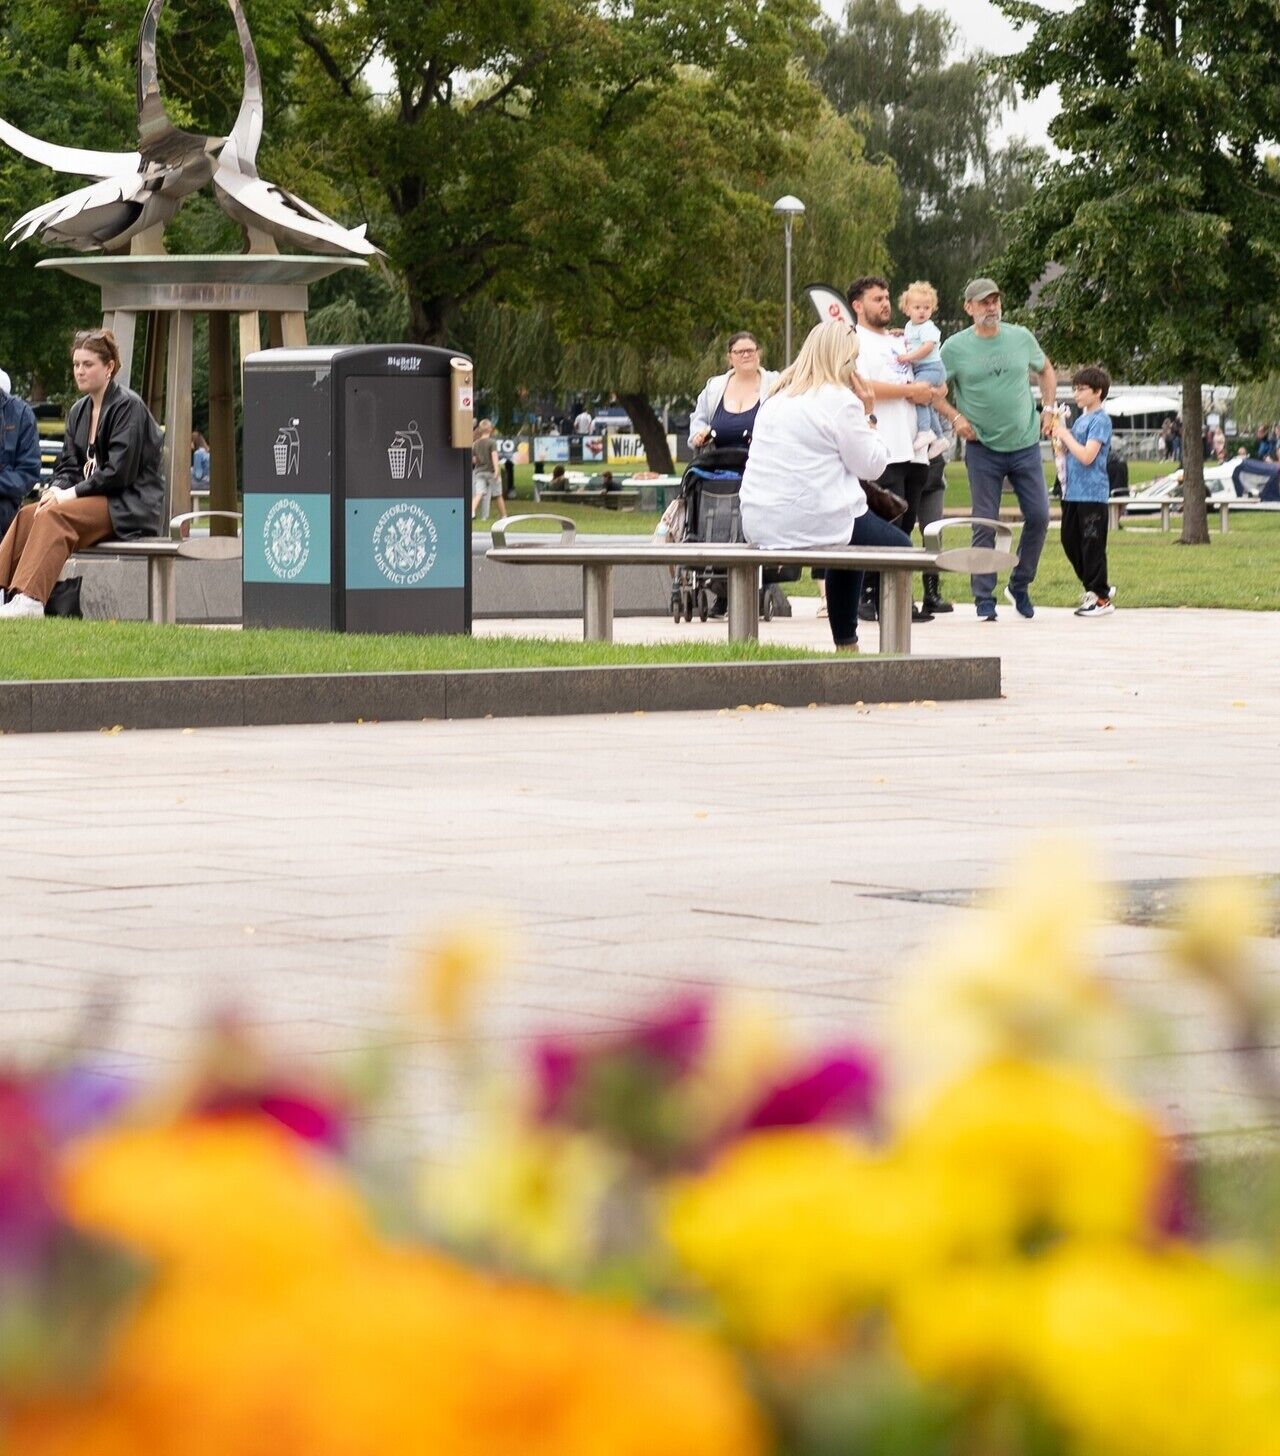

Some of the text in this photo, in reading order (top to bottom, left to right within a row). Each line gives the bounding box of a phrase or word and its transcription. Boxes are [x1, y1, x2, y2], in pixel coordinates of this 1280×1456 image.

[387, 356, 422, 367] BigBelly
[374, 552, 437, 584] DISTRICT COUNCIL
